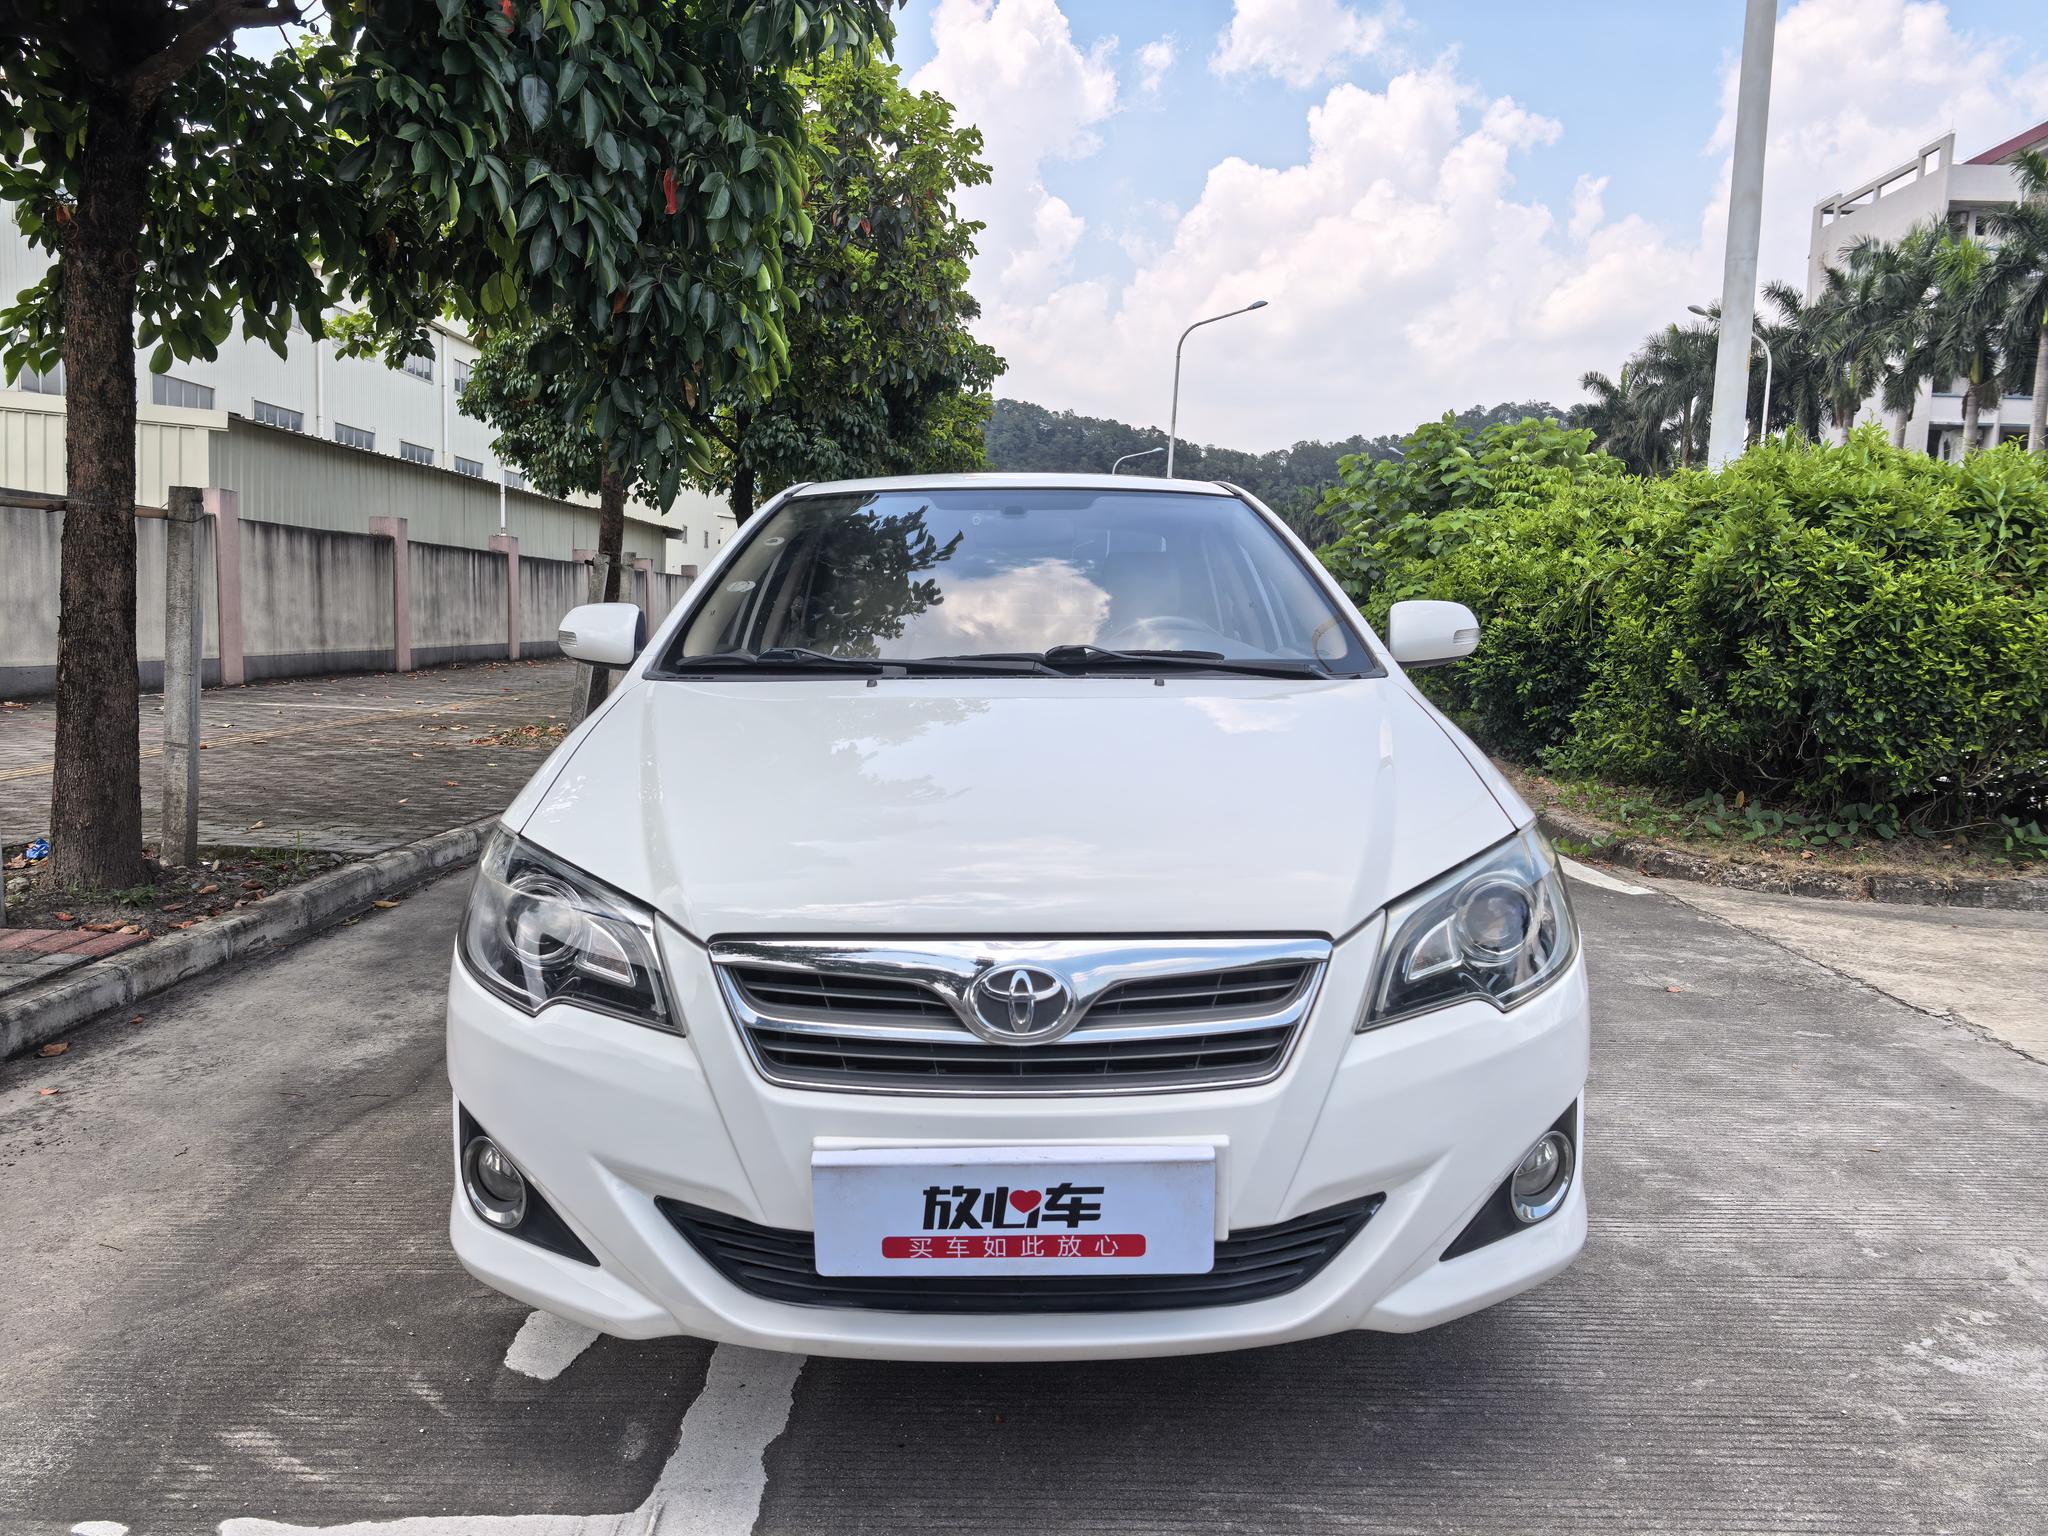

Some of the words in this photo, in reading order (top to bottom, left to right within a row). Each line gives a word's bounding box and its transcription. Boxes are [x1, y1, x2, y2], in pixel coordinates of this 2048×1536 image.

[923, 1183, 1104, 1230] 放心车
[909, 1236, 1118, 1258] 买车如此放心
